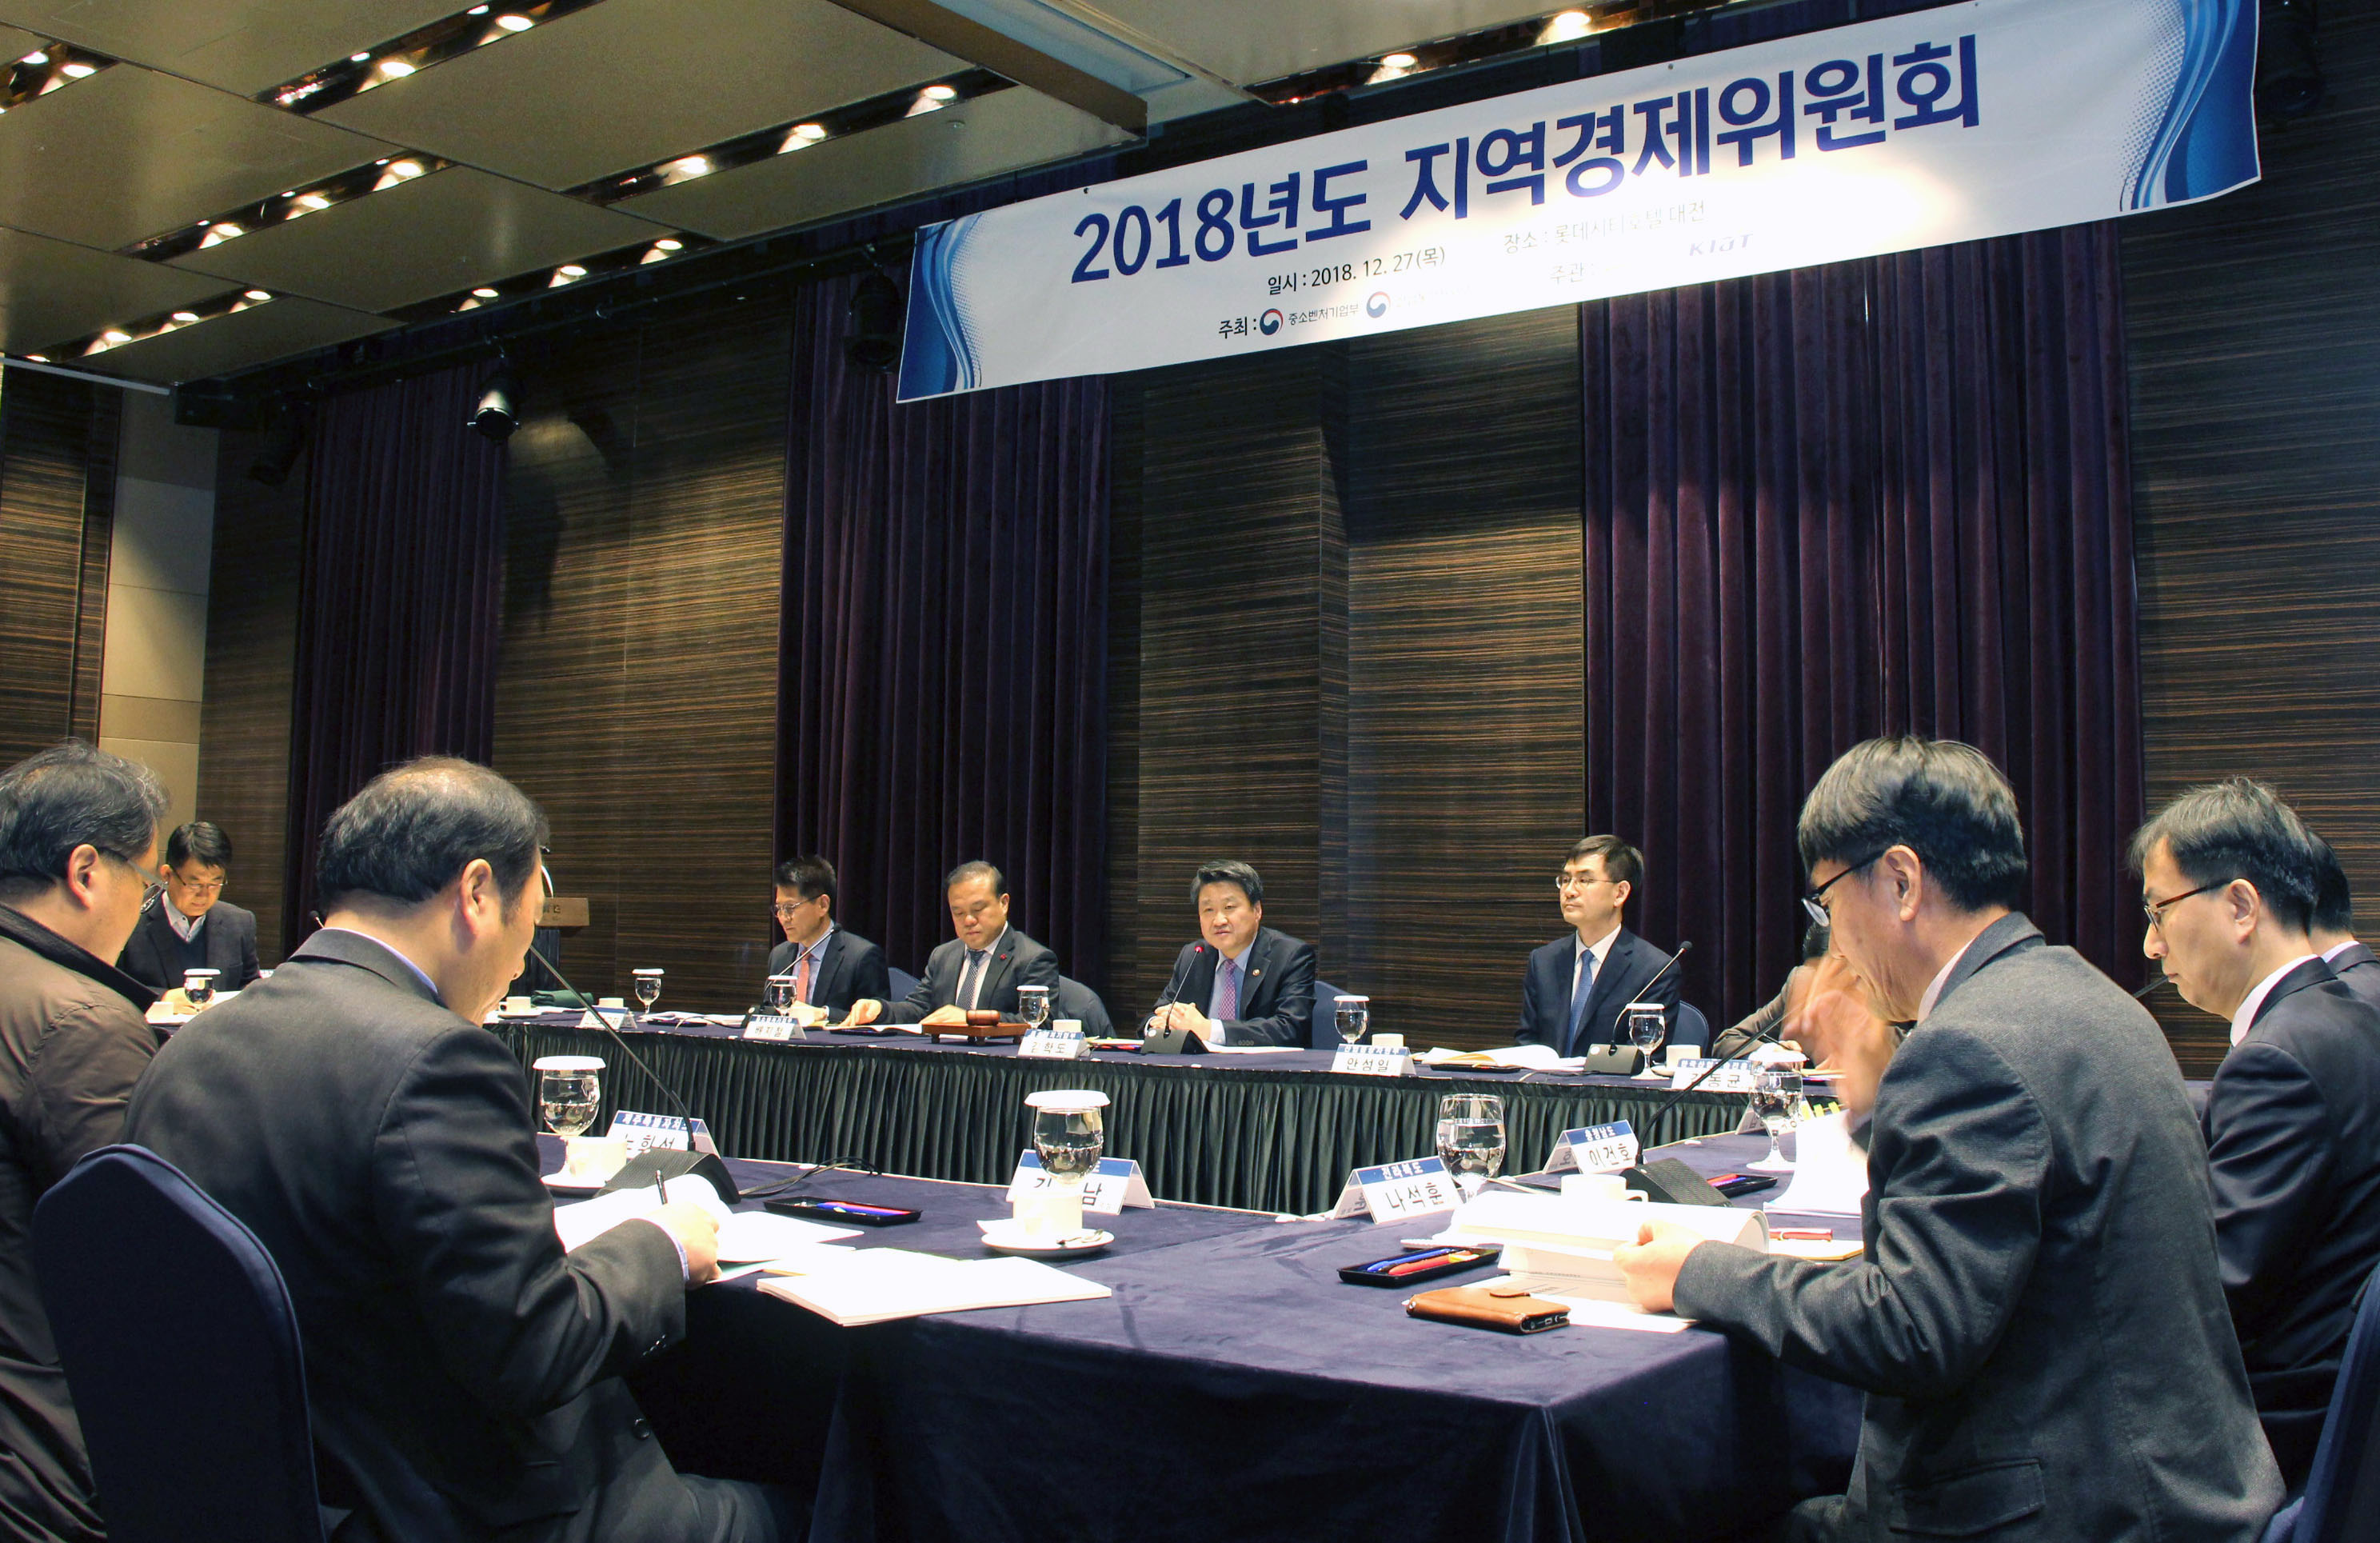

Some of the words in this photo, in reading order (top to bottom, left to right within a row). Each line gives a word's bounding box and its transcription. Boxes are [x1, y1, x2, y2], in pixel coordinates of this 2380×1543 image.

[1072, 159, 1372, 283] 2018년도
[1400, 34, 1979, 221] 지역경제위원회
[1503, 231, 1538, 254] 장소
[1669, 200, 1705, 224] 대전
[1268, 274, 1297, 295] 일시
[1312, 264, 1356, 287] 2018.
[1363, 258, 1387, 277] 12.
[1393, 246, 1445, 272] 27(목)
[1551, 262, 1583, 284] 주관
[1219, 317, 1248, 339] 주최
[1288, 304, 1360, 326] 중소벤처기업부
[1381, 1161, 1424, 1181] 전라북도
[1588, 1143, 1632, 1168] 이건호
[1385, 1181, 1444, 1212] 나석훈
